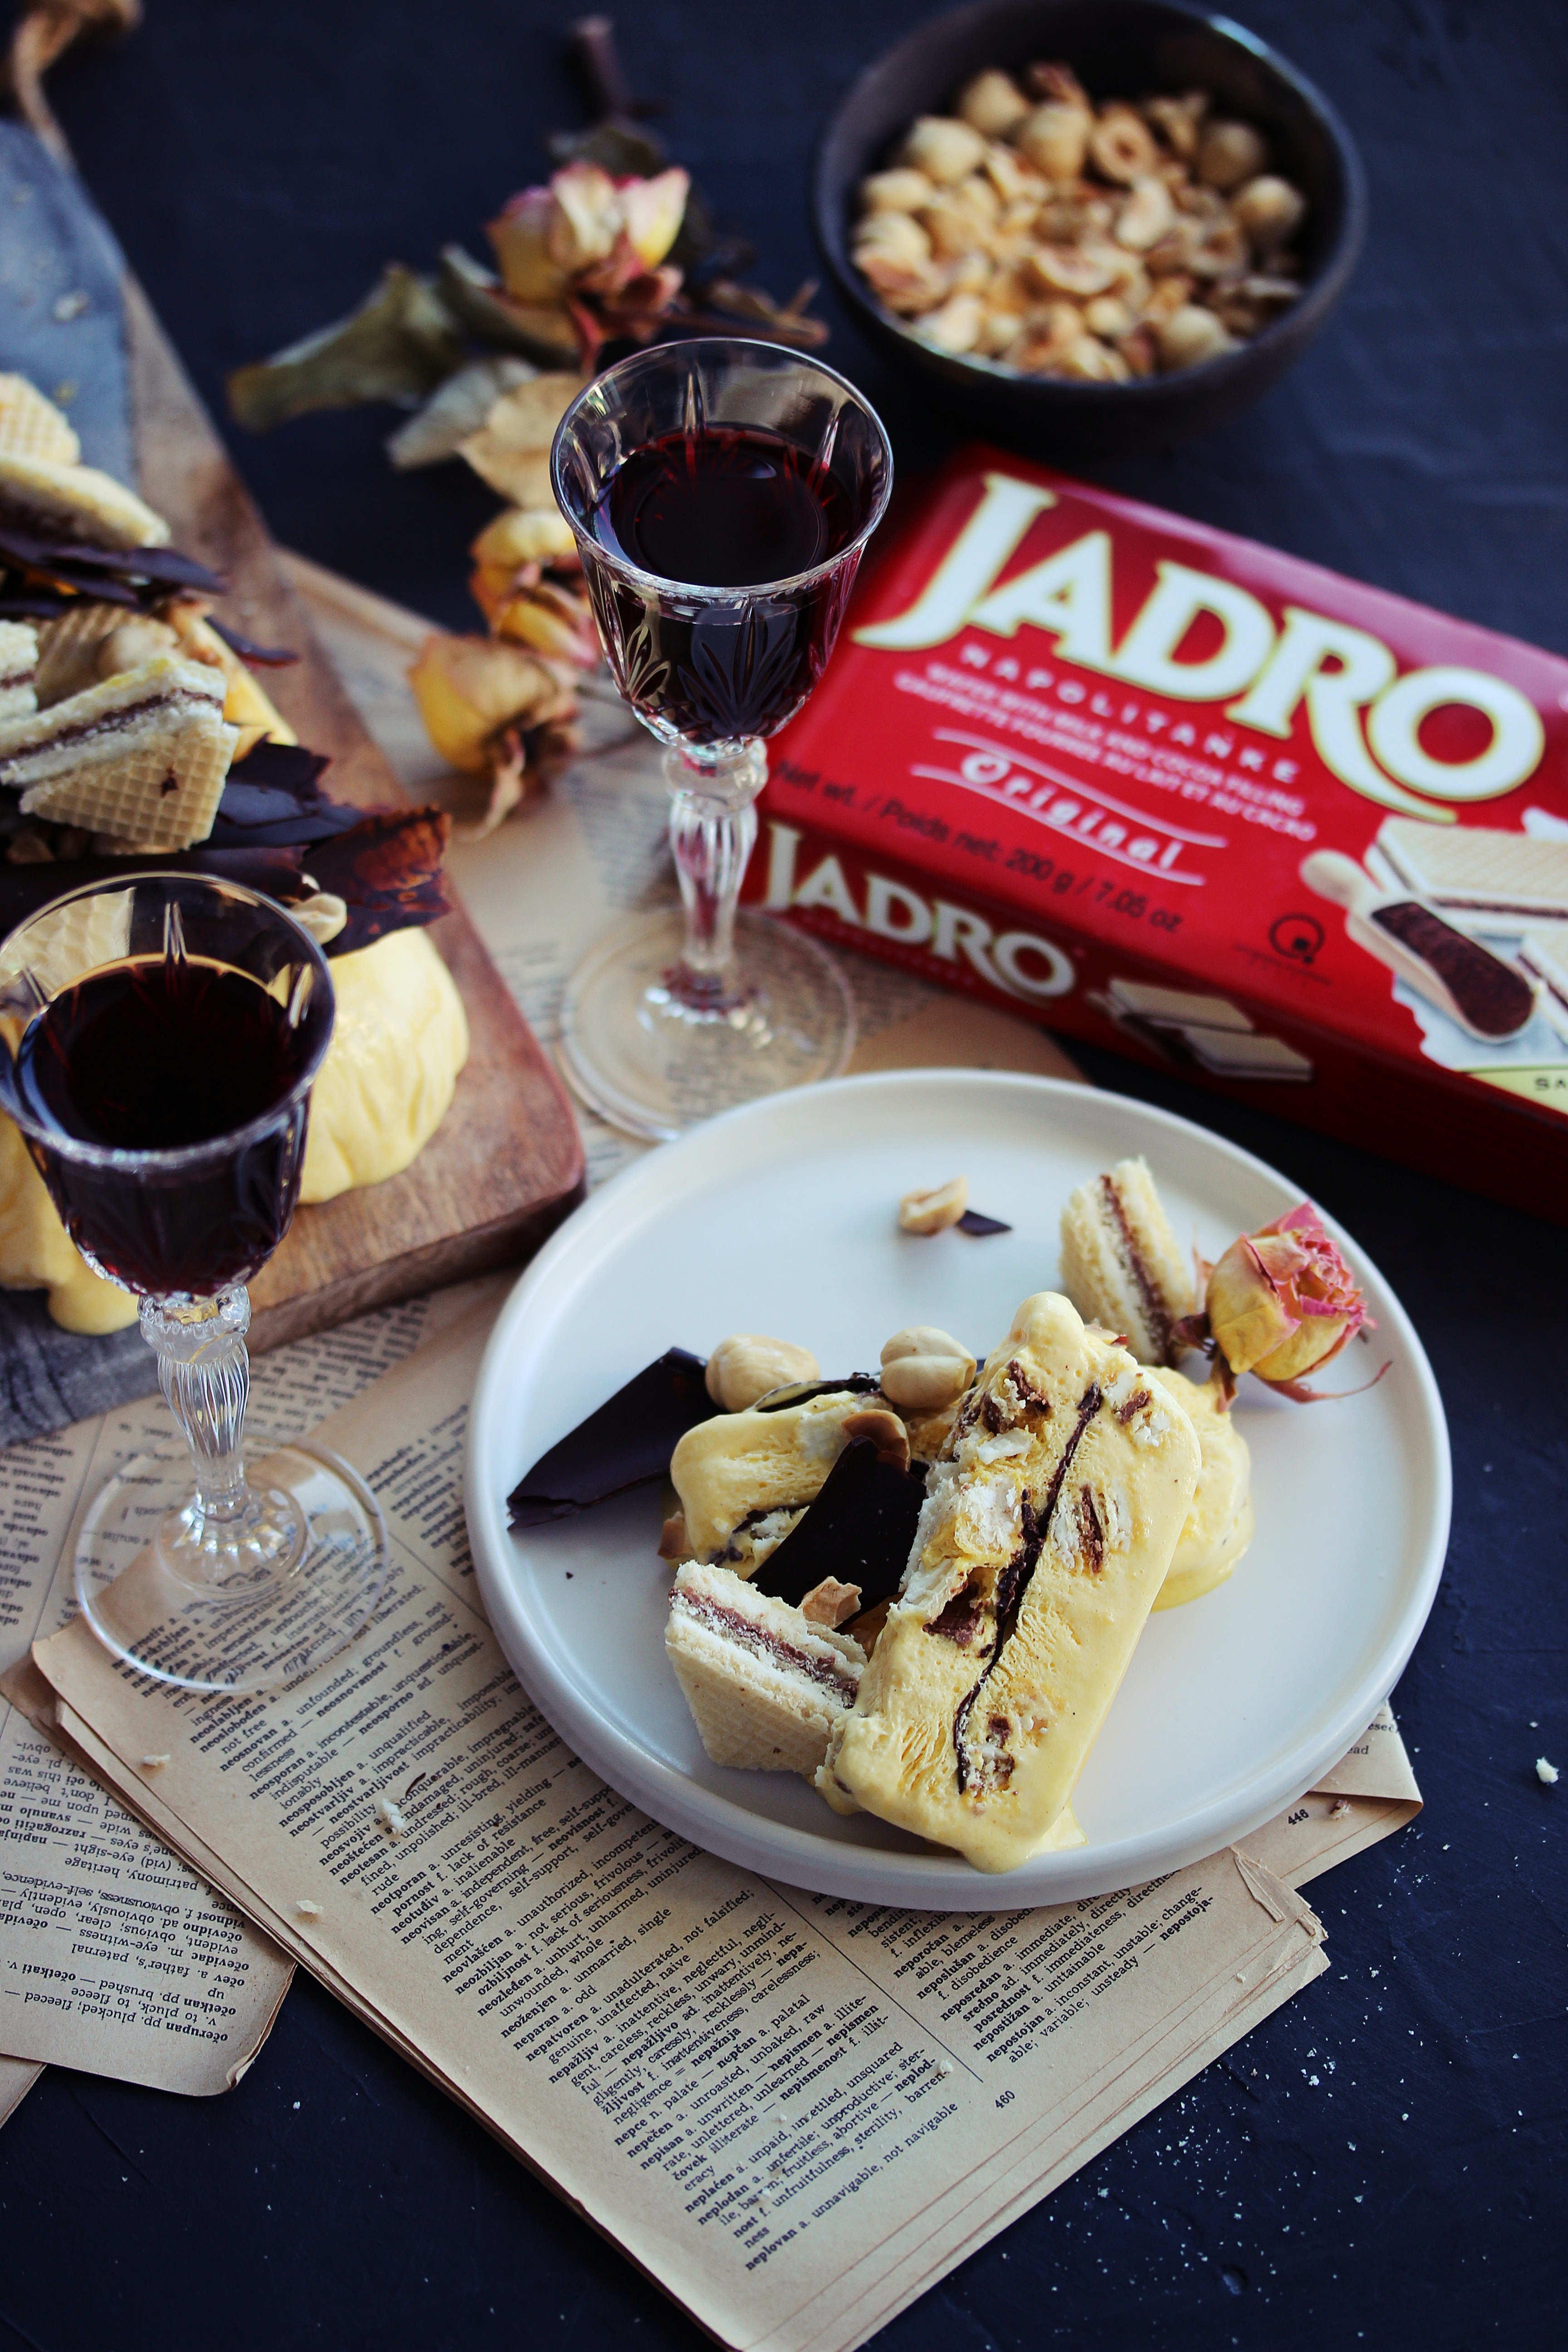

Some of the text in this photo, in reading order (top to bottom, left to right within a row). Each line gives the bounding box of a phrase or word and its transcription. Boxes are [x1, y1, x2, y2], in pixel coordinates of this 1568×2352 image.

[852, 472, 1545, 825] JADRO
[960, 642, 1299, 784] NAPOLITANKE
[960, 750, 1184, 871] Original
[762, 820, 1076, 1008] JADRO
[1004, 847, 1054, 882] 200
[1150, 909, 1183, 934] oz
[219, 1728, 279, 1773] neosnovan
[280, 1719, 294, 1728] a.
[361, 1620, 424, 1668] groundless,
[425, 1602, 446, 1619] not
[241, 1613, 455, 1773] confirmed neosnovanost f. ground-
[220, 1719, 268, 1755] not free
[248, 1747, 296, 1783] lessness
[278, 1710, 432, 1828] neosposobljen a. unqualified
[14, 1819, 139, 1850] eyes razrogačiti
[19, 1807, 132, 1836] wide svanulo
[40, 1797, 99, 1815] upon me
[64, 1856, 200, 1891] patrimony, heritage
[73, 1842, 172, 1872] (vid) eye-sight
[369, 1778, 553, 1916] neotporan a. unresisting, yielding
[2, 1870, 194, 1920] f. obviousness, self-evidence,
[19, 1887, 243, 1943] očevidno ad. obviously, evidently
[31, 1902, 67, 1919] open,
[75, 1911, 112, 1931] clear,
[71, 1943, 131, 1963] paternal
[78, 1928, 250, 1973] očevidac m. eye-witness
[185, 1934, 239, 1955] evident,
[197, 1969, 209, 1980] a.
[500, 1908, 672, 2039] neoženjen a. unmarried, single
[524, 1889, 755, 2063] nepatvoren a. unadulterated, not falsified;
[892, 1924, 965, 1979] neporočan a.
[915, 1914, 996, 1980] able, blemeless
[916, 1943, 990, 2000] neposlušan a.
[937, 1936, 1019, 2001] f. disobedience
[939, 1915, 1077, 2022] neposredan a. immediate,
[962, 1991, 1000, 2023] sredno
[1001, 1975, 1020, 1991] ad.
[1020, 1921, 1091, 1976] immediately,
[972, 1911, 1127, 2034] posrednost f. immediateness,
[985, 1886, 1203, 2063] nepostojan a. inconstant, unstable; change-
[6, 1960, 237, 2018] očetkan pp. brushed očetkati v.
[70, 1987, 217, 2027] v. to pluck, to fleece
[207, 1987, 229, 2000] up
[213, 1974, 245, 1989] očev
[972, 1943, 1106, 2052] nepostižan a. unttainable
[1008, 1896, 1214, 2063] able; variable; unsteady nepostoja-
[24, 1991, 229, 2044] očerupan pp. plucked; fleeced
[512, 1984, 598, 2051] neparan a. odd
[613, 1993, 811, 2147] nepce n. palate nepčan a. palatal
[626, 2004, 825, 2159] nepečen a. unroasted, unbaked, raw
[639, 1995, 867, 2171] nepisan a. unwritten nepismen a. illite-
[995, 2090, 1015, 2109] 460
[744, 2103, 958, 2272] neplovan a. unnavigable, not navigable
